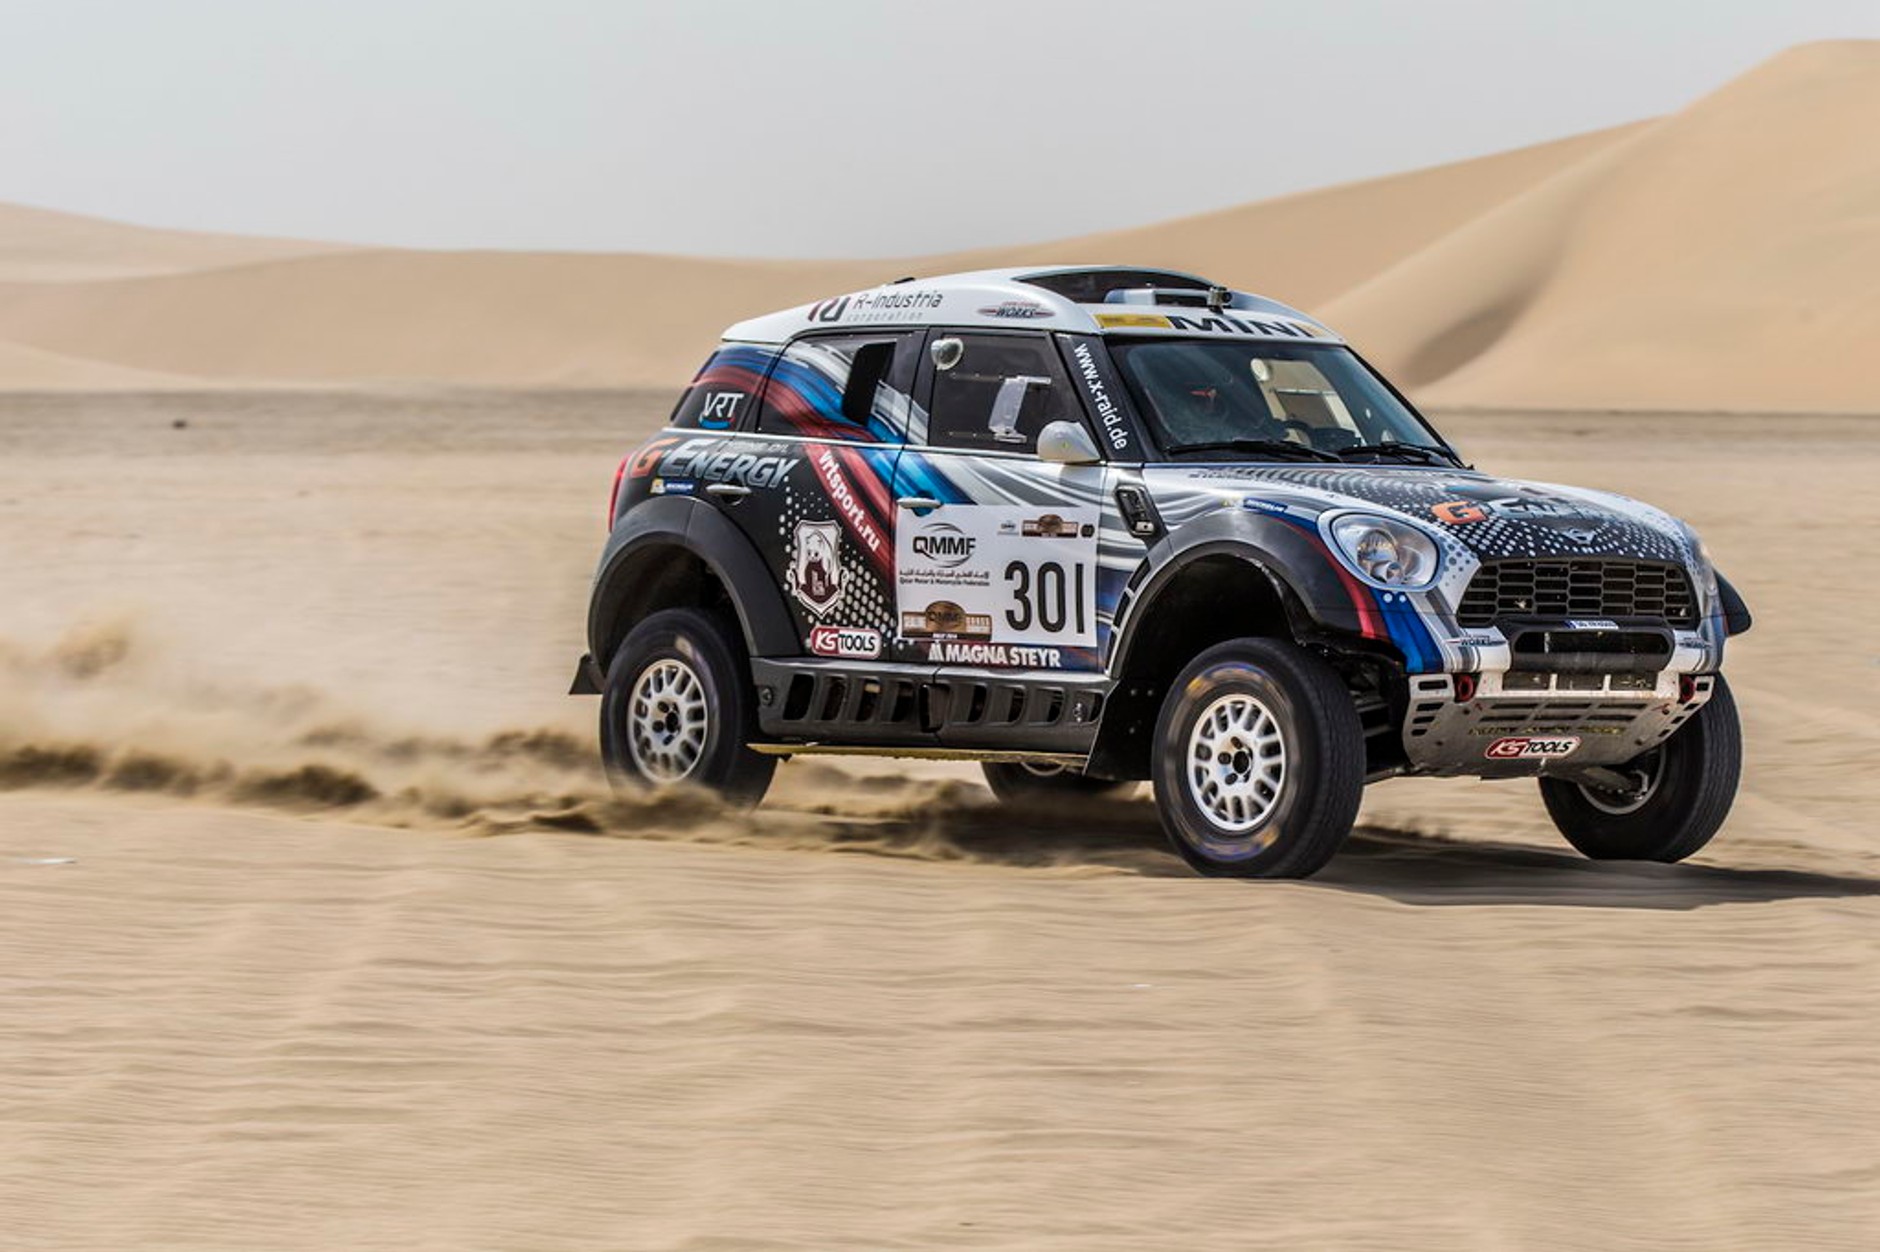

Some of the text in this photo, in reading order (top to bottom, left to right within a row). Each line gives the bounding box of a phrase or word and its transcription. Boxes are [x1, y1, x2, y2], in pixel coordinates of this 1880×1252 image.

[1165, 315, 1315, 338] MINI
[703, 392, 745, 418] VRT
[1075, 343, 1129, 450] www.x-raid.de
[818, 449, 880, 552] vrtsport.ru
[912, 536, 977, 561] QMMF
[1004, 560, 1085, 634] 301
[815, 630, 876, 652] KS TOOLS
[946, 645, 1062, 668] MAGNA STEYR
[1525, 741, 1574, 753] TOOLS
